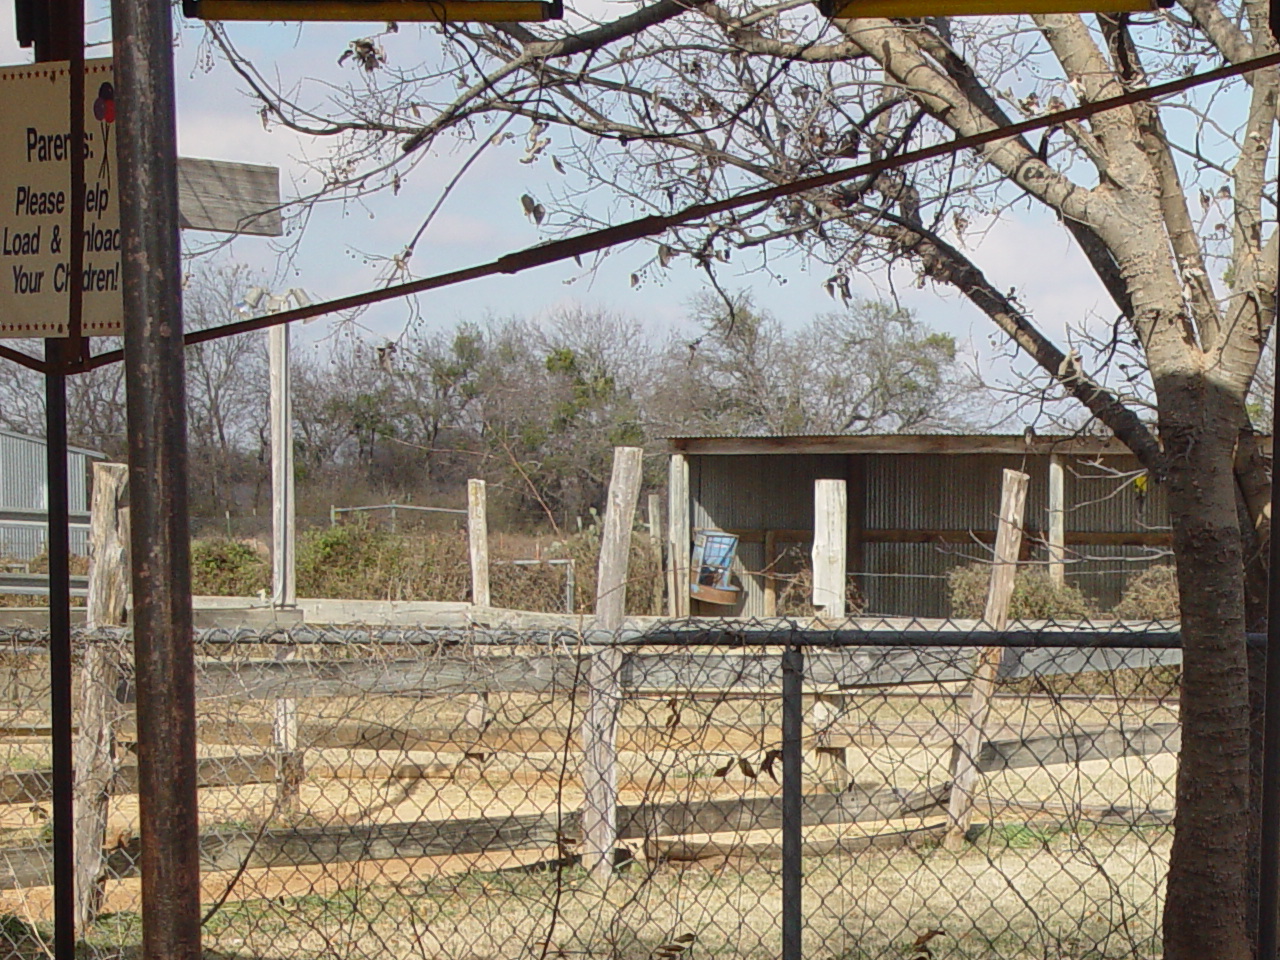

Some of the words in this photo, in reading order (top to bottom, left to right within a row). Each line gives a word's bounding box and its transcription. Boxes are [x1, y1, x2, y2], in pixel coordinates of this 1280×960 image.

[26, 127, 94, 163] Parens:
[15, 186, 65, 216] Please
[83, 182, 109, 220] elp
[3, 225, 41, 256] Load
[50, 224, 62, 254] &
[82, 222, 121, 252] nloa
[12, 264, 45, 294] Your
[53, 261, 120, 293] Chdren!
